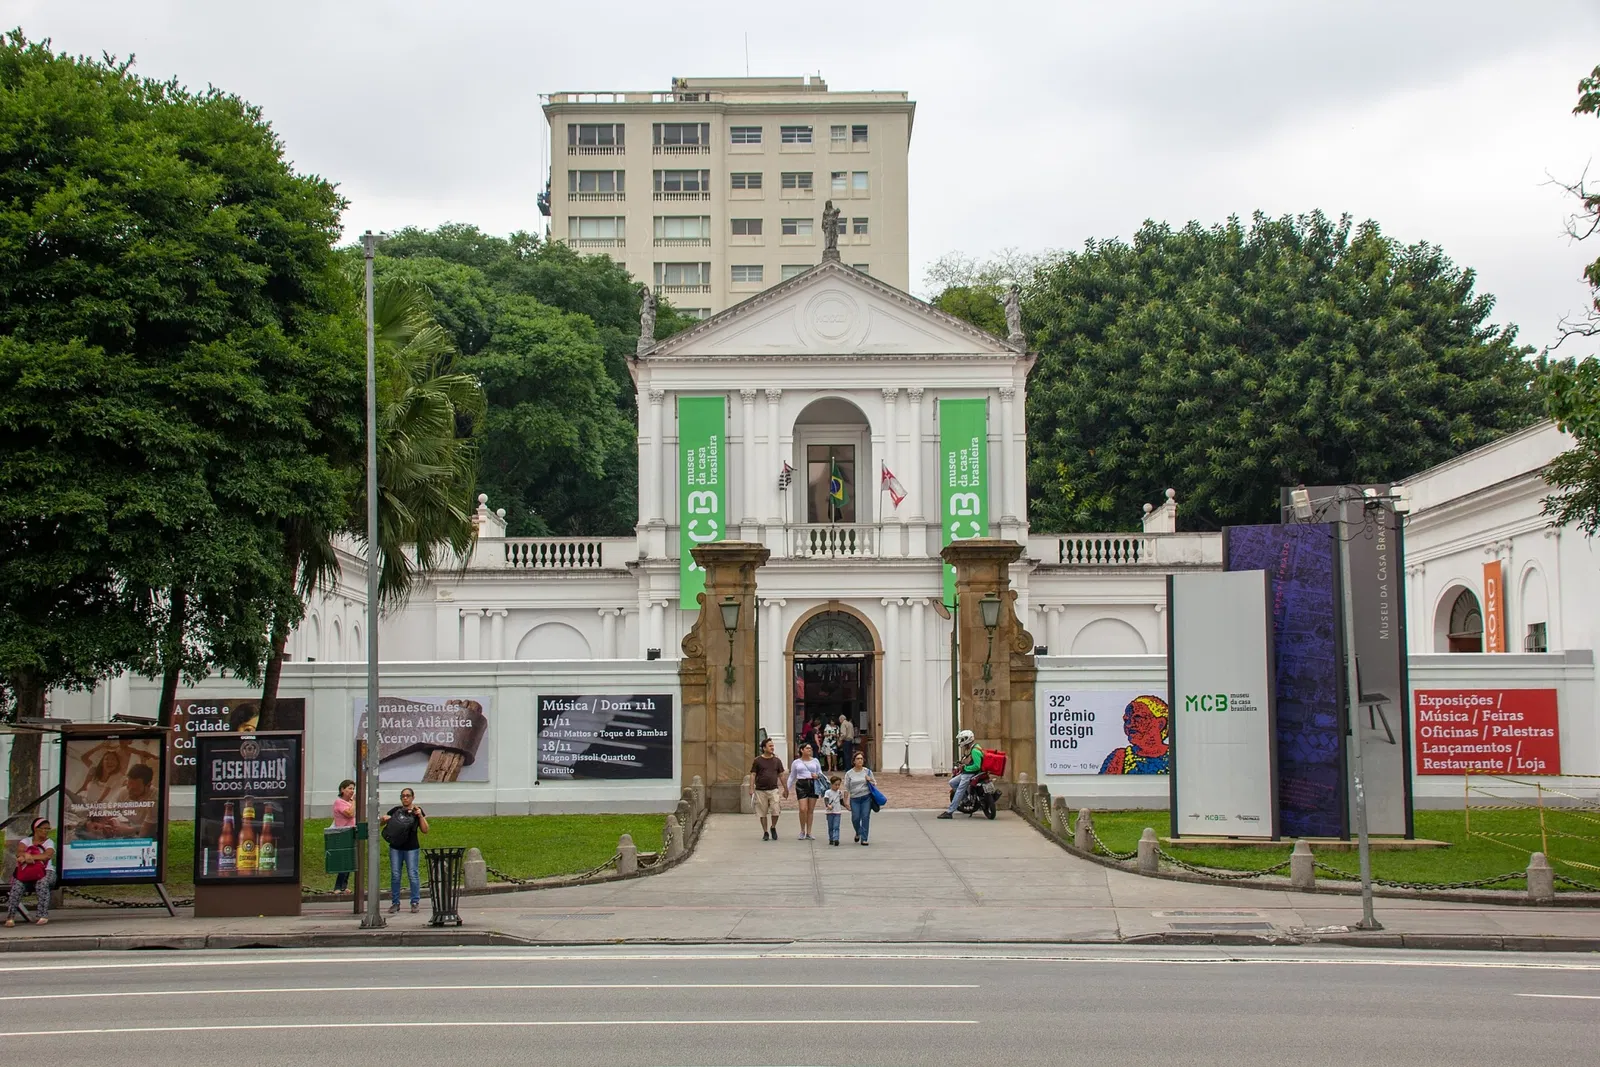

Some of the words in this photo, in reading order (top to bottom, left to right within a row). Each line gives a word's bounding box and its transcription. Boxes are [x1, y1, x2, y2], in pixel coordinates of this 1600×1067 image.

[687, 449, 695, 485] museu
[707, 435, 718, 485] brasileira
[960, 448, 968, 473] casa
[969, 437, 979, 487] brasileira
[695, 474, 706, 485] da
[957, 475, 968, 487] da
[542, 698, 588, 711] Música
[591, 698, 598, 714] /
[601, 699, 632, 711] Dom
[636, 698, 656, 711] 11h
[1185, 693, 1228, 712] MCB
[1418, 694, 1494, 709] Exposições
[1496, 693, 1503, 709] /
[173, 704, 183, 715] A
[187, 703, 218, 715] Casa
[221, 706, 229, 715] e
[1050, 709, 1095, 723] prêmio
[382, 717, 413, 728] Mata
[416, 715, 472, 728] Atlântica
[542, 714, 571, 729] 11/11
[1419, 709, 1469, 722] Música
[1472, 708, 1479, 725] /
[1482, 709, 1525, 722] Feiras
[174, 723, 181, 732] a
[185, 720, 230, 732] Cidade
[1049, 723, 1093, 738] design
[1420, 725, 1480, 738] Oficinas
[1482, 725, 1489, 741] /
[1492, 725, 1555, 737] Palestras
[378, 733, 418, 743] Acervo
[421, 732, 455, 743] MCB
[542, 730, 562, 738] Dani
[564, 730, 592, 738] Mattos
[600, 730, 624, 739] Toque
[625, 729, 635, 737] de
[636, 728, 668, 737] Bambas
[174, 736, 196, 749] Col
[542, 739, 572, 755] 18/11
[1049, 737, 1078, 749] mcb
[1422, 741, 1513, 756] Lançamentos
[1515, 740, 1522, 757] /
[174, 755, 196, 766] Cre
[542, 754, 570, 763] Magno
[572, 753, 599, 761] Bissoli
[600, 753, 636, 763] Quarteto
[1423, 757, 1505, 770] Restaurante
[1506, 756, 1513, 773] /
[1516, 757, 1547, 772] Loja
[211, 758, 287, 781] EISENBAHN
[542, 766, 575, 774] Gratuito
[1088, 762, 1099, 770] fev
[212, 781, 243, 790] TODOS
[244, 781, 252, 790] A
[253, 780, 287, 790] BORDO
[113, 800, 155, 809] PRIORIDADE?
